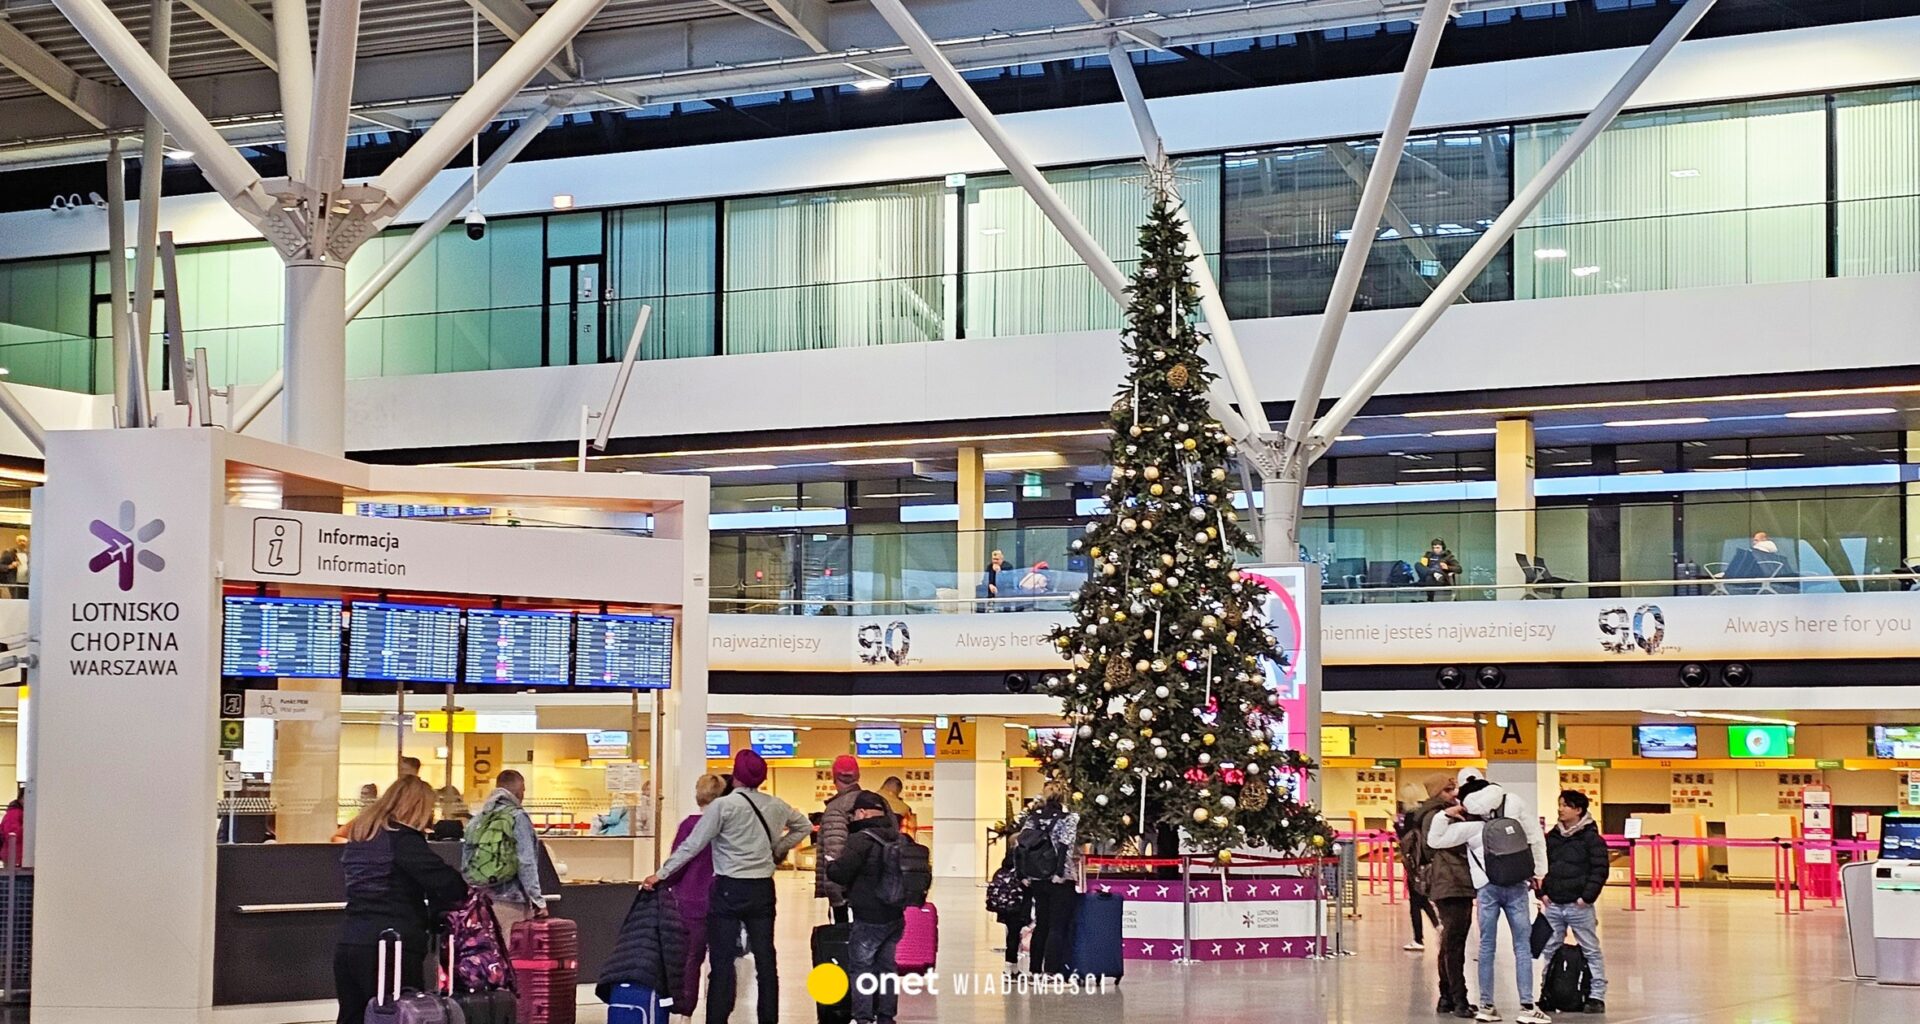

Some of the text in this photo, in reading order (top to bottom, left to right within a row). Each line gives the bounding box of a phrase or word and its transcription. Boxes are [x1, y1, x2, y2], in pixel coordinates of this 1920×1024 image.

[318, 528, 399, 552] Informacja
[317, 555, 406, 576] Information
[72, 602, 179, 621] LOTNISKO
[1383, 623, 1432, 644] jesteś
[1438, 621, 1556, 643] najważniejszy
[1724, 615, 1912, 637] Always here for you
[70, 632, 179, 652] CHOPINA
[712, 634, 821, 653] najważniejszy
[956, 632, 1043, 651] Always here
[70, 660, 178, 676] WARSZAWA
[946, 721, 964, 745] A
[1501, 718, 1522, 744] A
